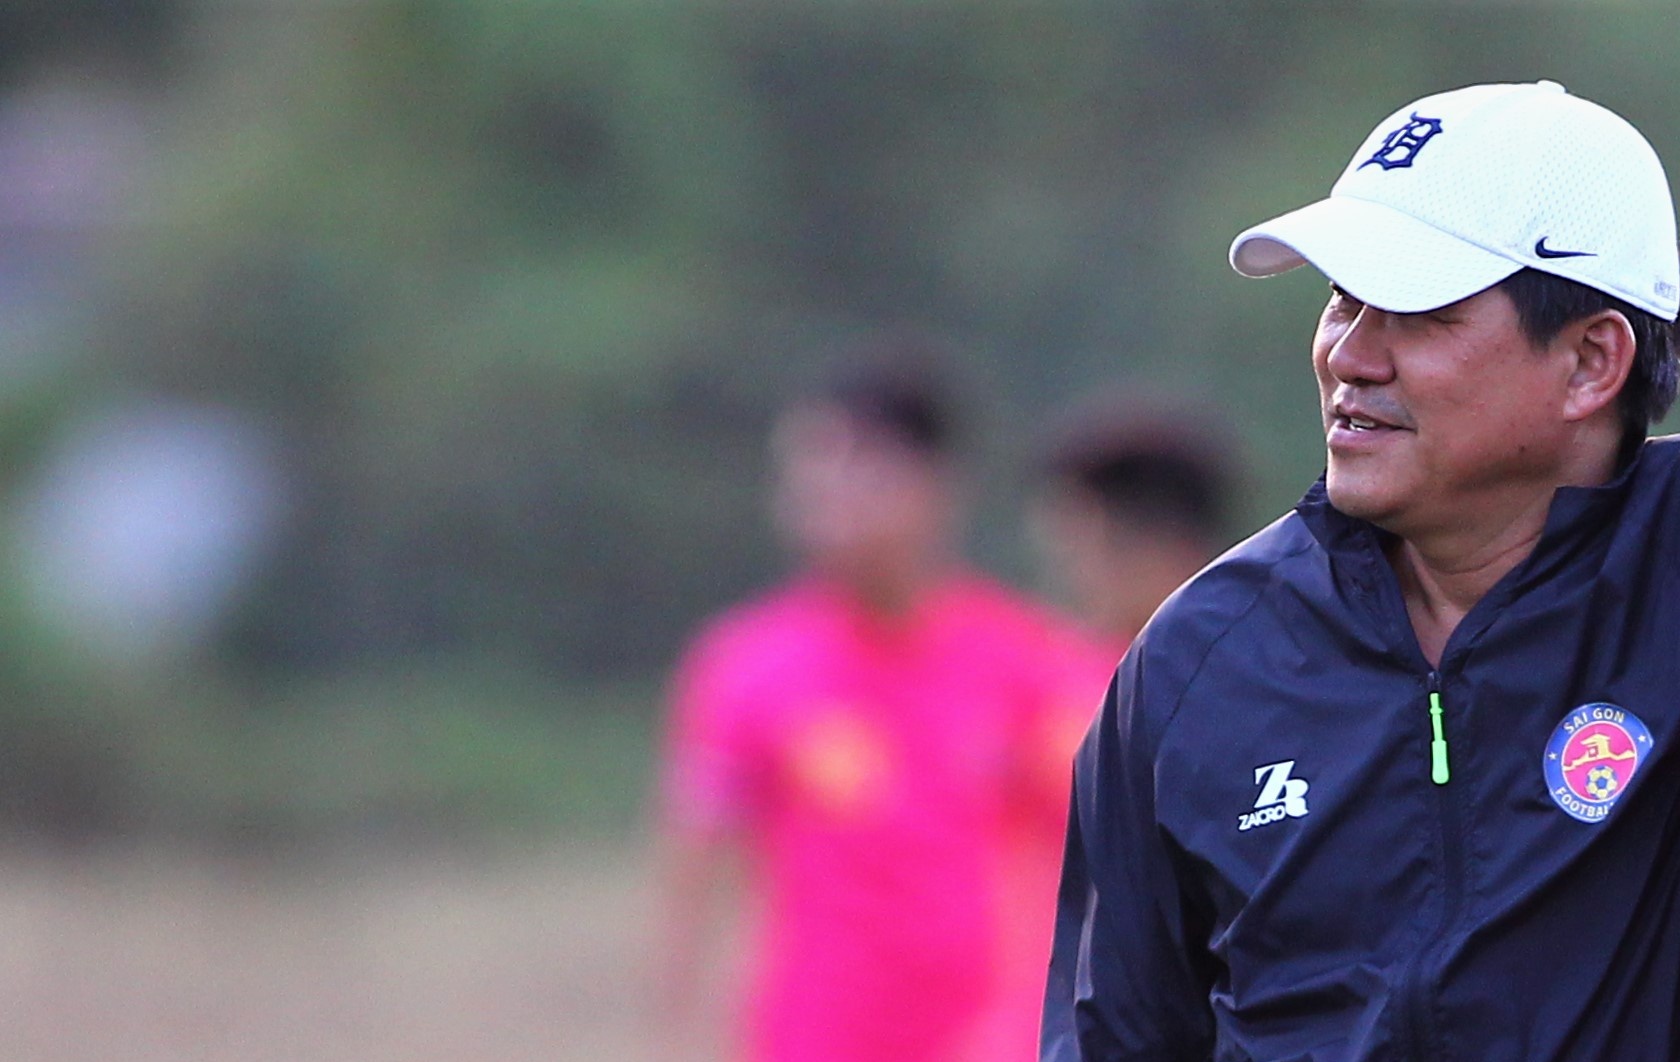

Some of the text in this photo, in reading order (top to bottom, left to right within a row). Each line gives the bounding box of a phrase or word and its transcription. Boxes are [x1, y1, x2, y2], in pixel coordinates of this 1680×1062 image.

[1563, 707, 1625, 734] SAI GON
[1555, 786, 1615, 817] FOOTBAL
